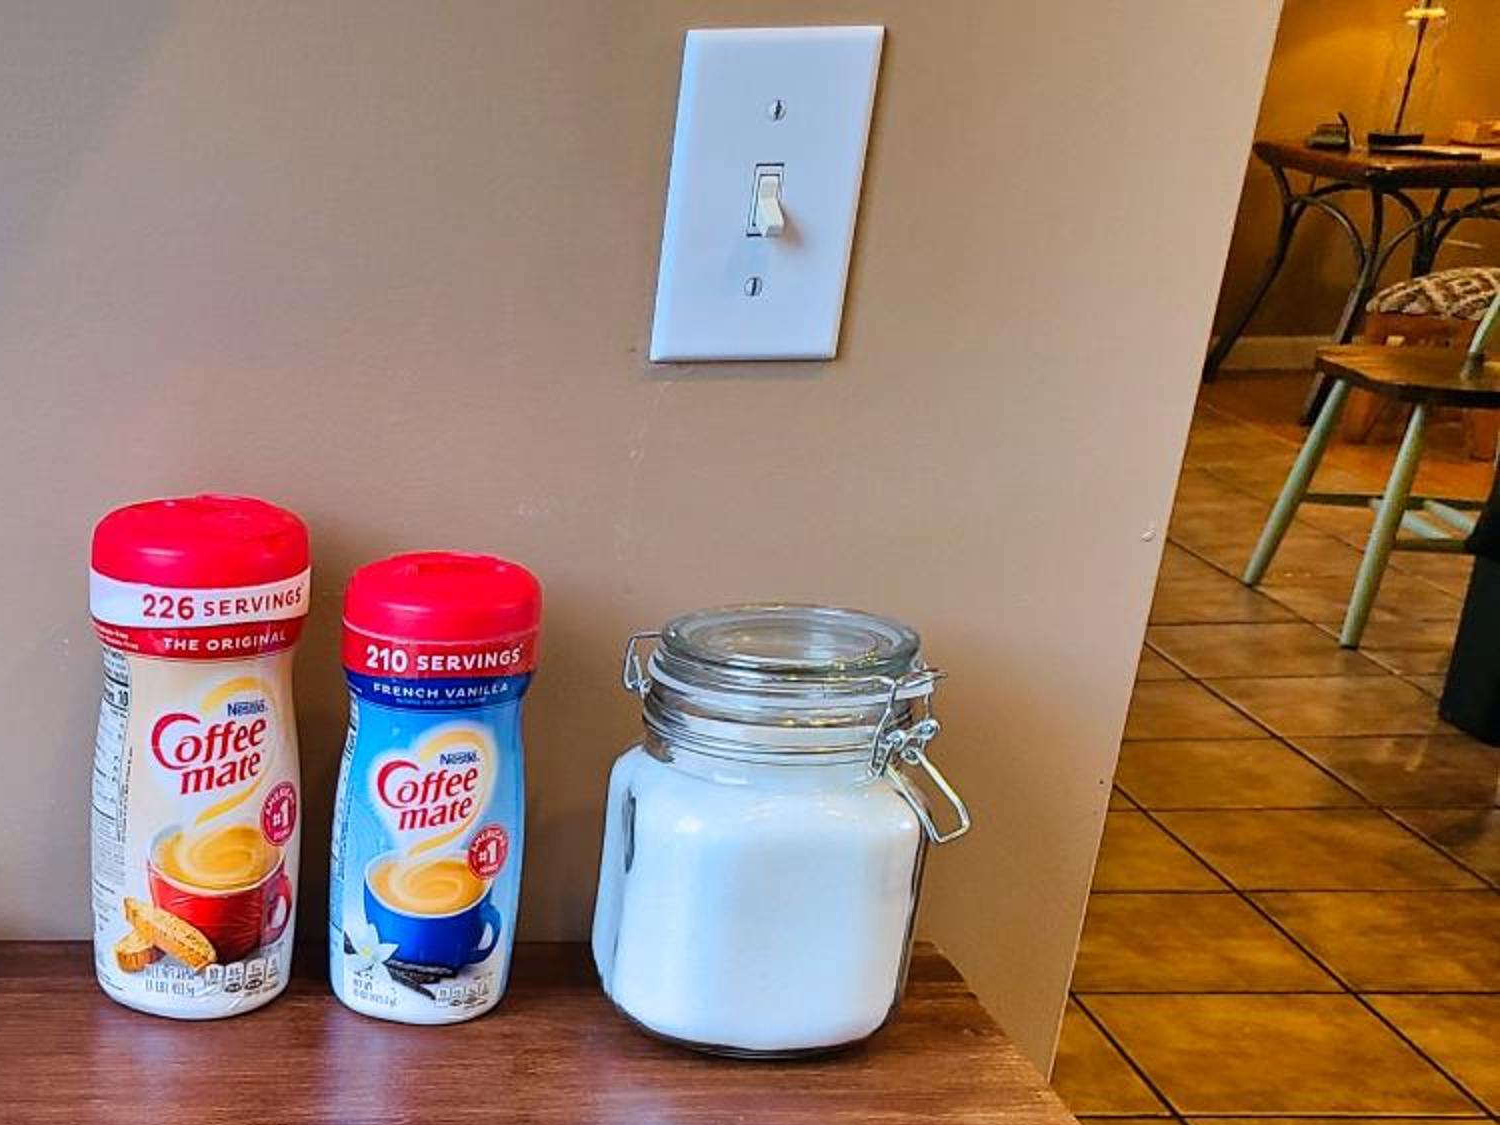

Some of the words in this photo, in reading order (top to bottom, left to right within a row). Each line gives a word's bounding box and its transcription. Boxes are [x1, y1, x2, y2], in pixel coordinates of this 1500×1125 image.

[142, 593, 195, 620] 226
[203, 586, 302, 617] SERVINGS
[163, 637, 200, 651] THE
[205, 630, 287, 651] ORIGINAL
[366, 645, 409, 674] 210
[416, 647, 520, 671] SERVINGS
[373, 682, 439, 699] FRENCH
[445, 682, 509, 699] VANILLA
[151, 712, 267, 770] Coffee
[180, 752, 261, 795] mate
[377, 760, 479, 809] Coffee
[272, 799, 289, 827] #1
[398, 797, 473, 831] mate
[478, 839, 498, 864] #1
